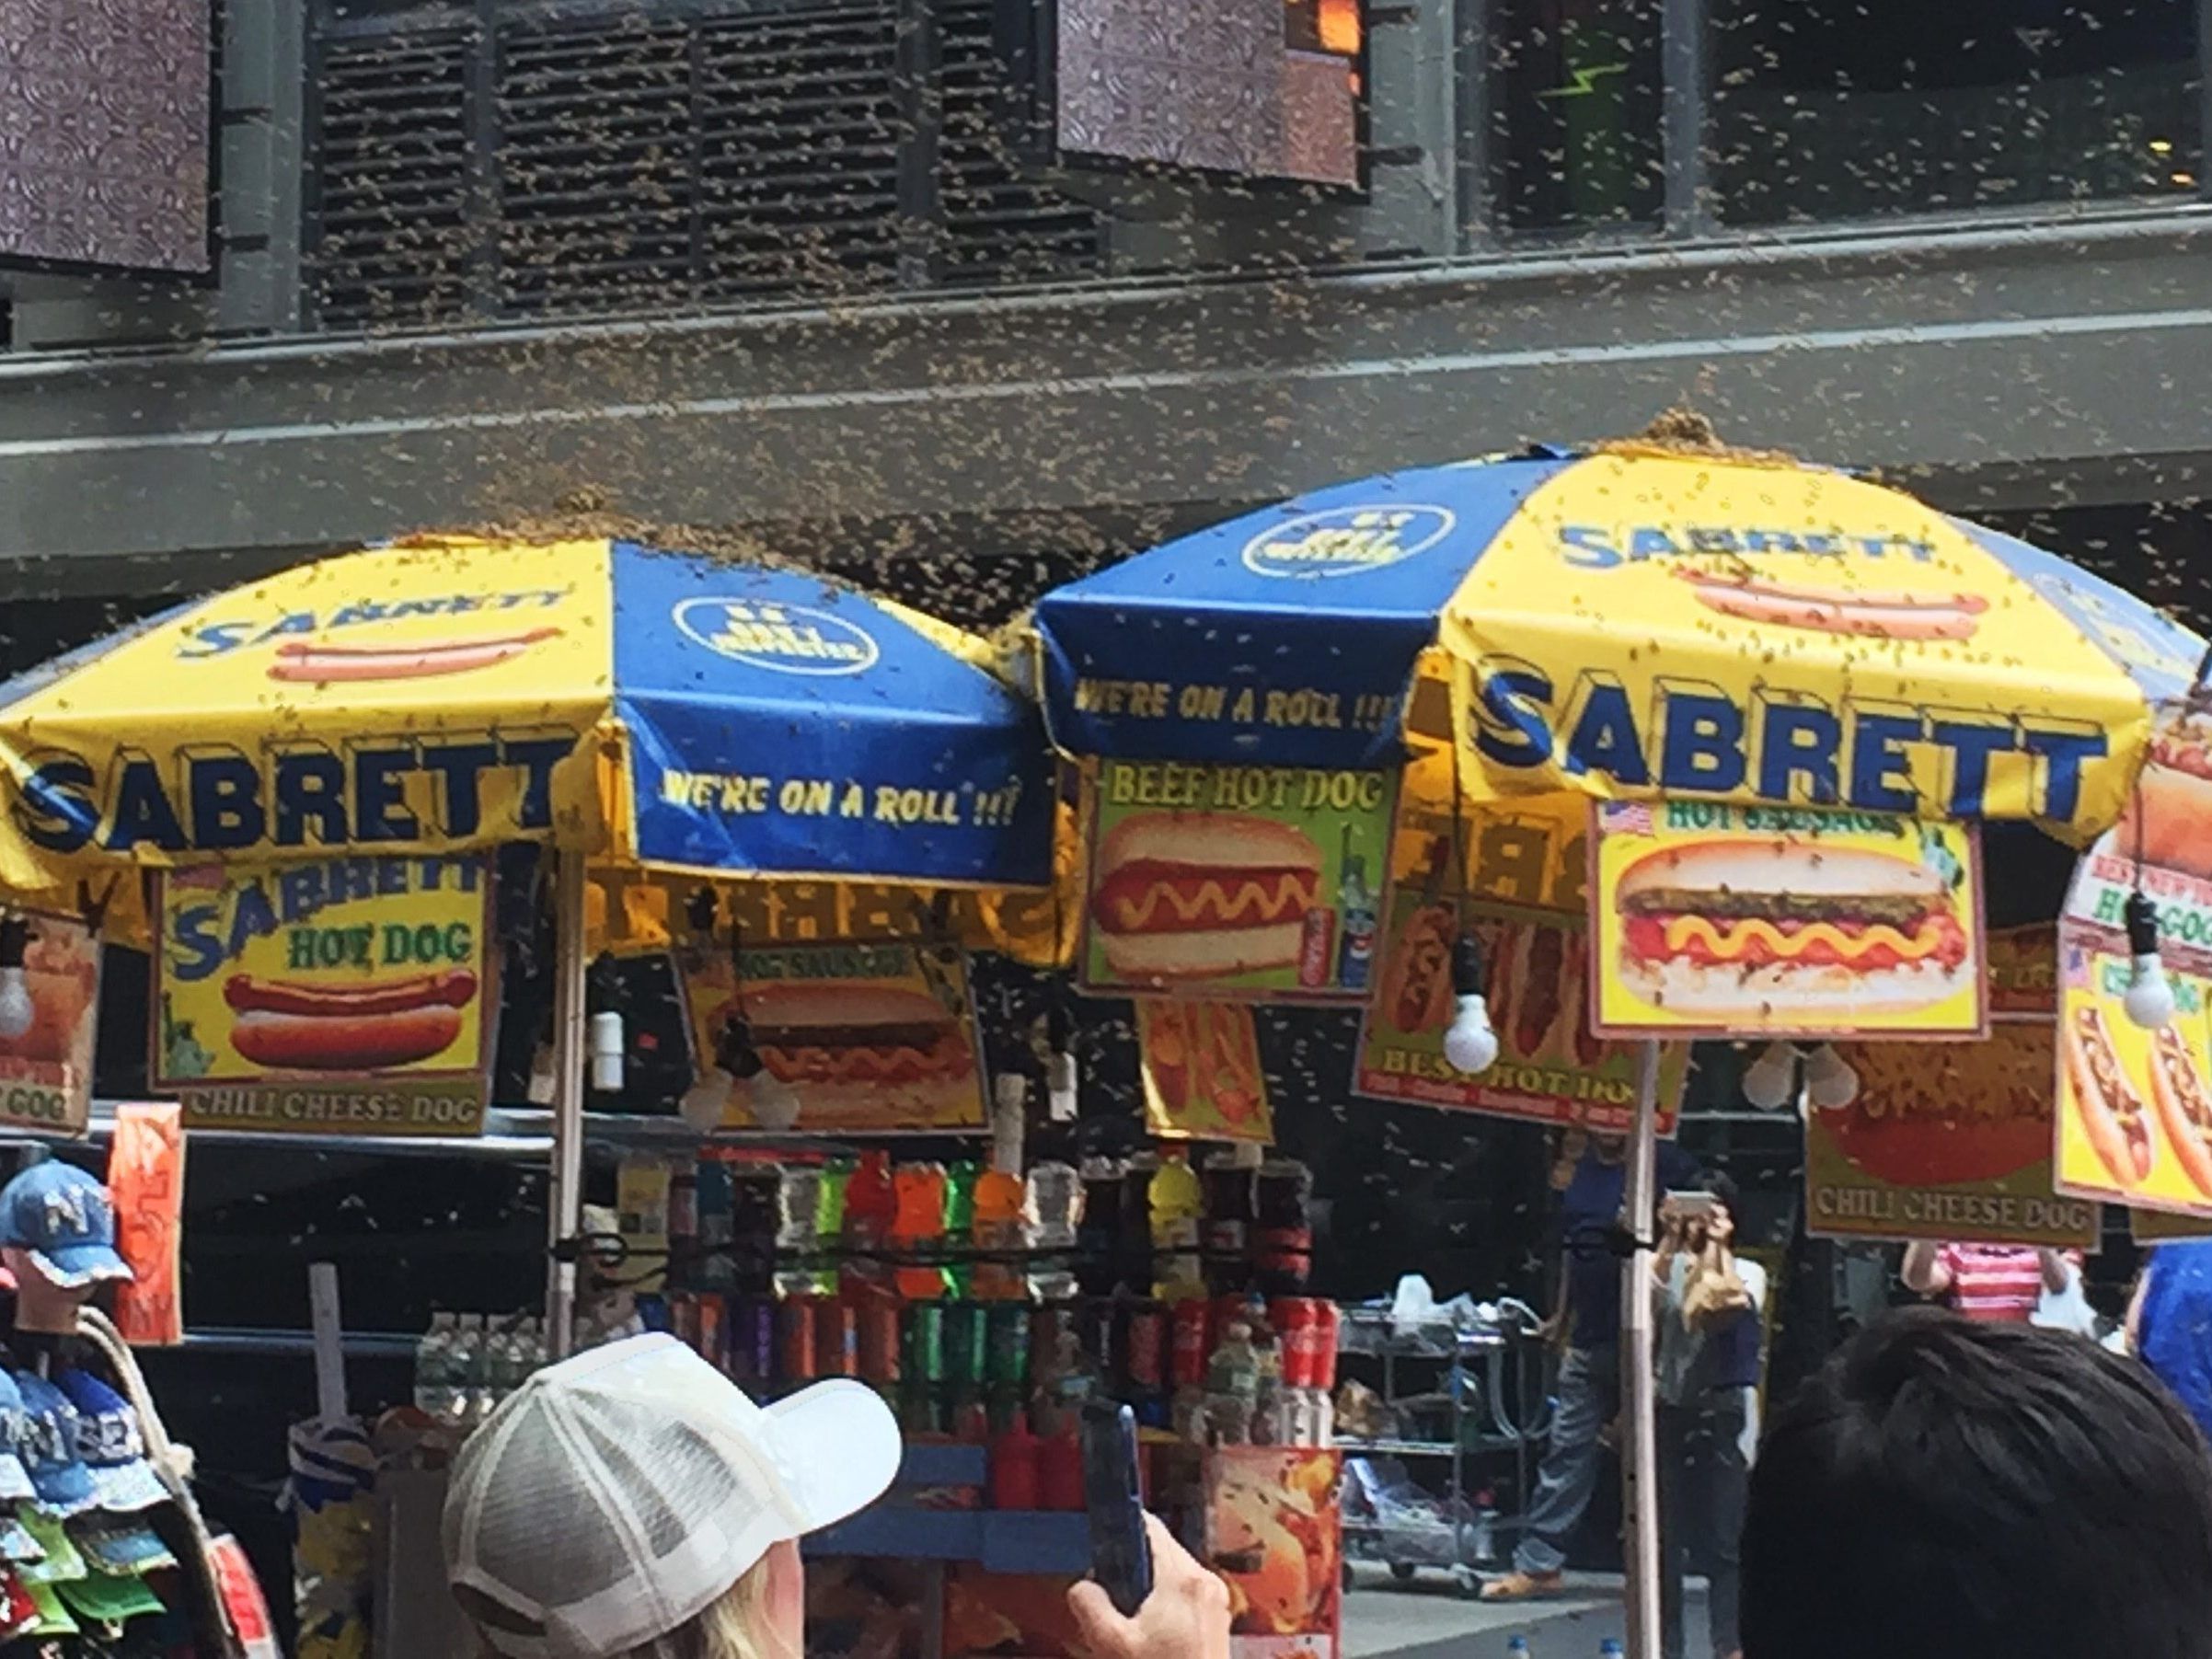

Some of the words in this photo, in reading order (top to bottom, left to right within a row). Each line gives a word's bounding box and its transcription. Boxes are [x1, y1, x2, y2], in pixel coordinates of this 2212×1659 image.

[1073, 678, 1171, 718] WE'RE
[1178, 685, 1227, 721] ON
[1231, 688, 1256, 723] A
[1263, 688, 1342, 729] ROLL
[1469, 652, 2109, 824] SABRETT
[11, 724, 585, 855] SABRETT
[662, 766, 771, 813] WE'RE
[779, 780, 832, 815] ON
[840, 783, 865, 818] A
[874, 787, 960, 825] ROLL
[1111, 765, 1205, 806] BEEF
[1213, 766, 1293, 812] HOT
[1300, 770, 1384, 813] DOG
[290, 925, 373, 971] HOT
[383, 922, 472, 965] DOG
[283, 1091, 404, 1123] CHEESE
[411, 1097, 477, 1124] DOG
[1903, 1191, 2017, 1227] CHEESE
[2023, 1198, 2087, 1231] DOG
